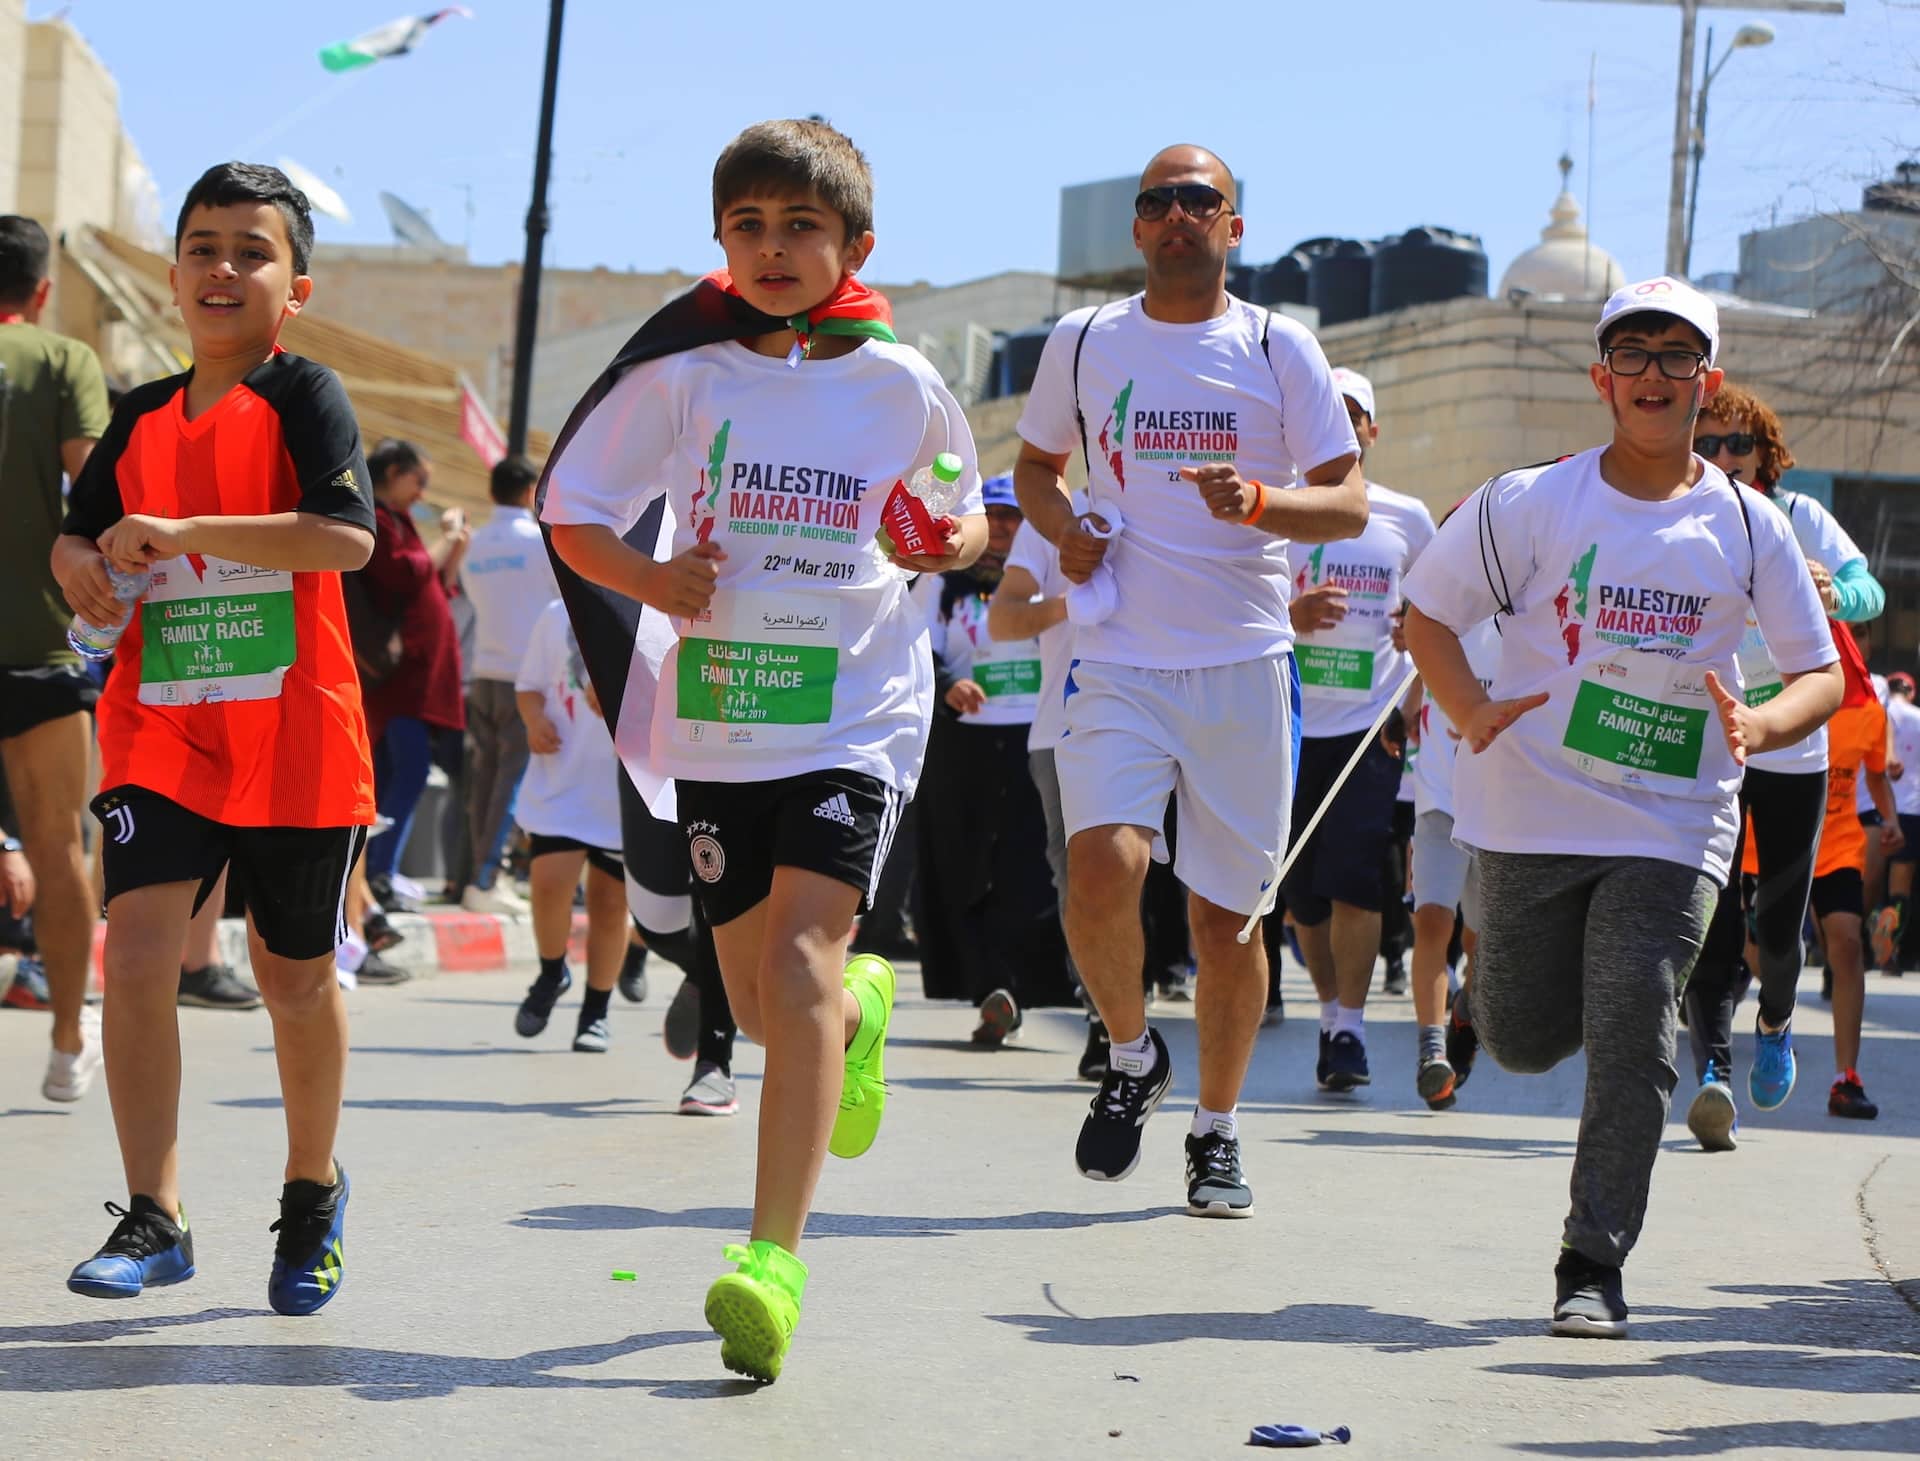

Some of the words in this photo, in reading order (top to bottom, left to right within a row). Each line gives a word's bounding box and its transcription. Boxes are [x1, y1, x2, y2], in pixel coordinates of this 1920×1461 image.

[1134, 411, 1237, 431] PALESTINE
[1134, 431, 1237, 451] MARATHON
[1135, 451, 1173, 460] FREEDOM
[1176, 452, 1187, 460] OF
[1189, 452, 1235, 461] MOVEMENT
[731, 462, 867, 501] PALESTINE
[1168, 471, 1181, 481] 22
[729, 492, 860, 530] MARATHON
[728, 520, 779, 537] FREEDOM
[782, 524, 797, 537] OF
[800, 526, 857, 545] MOVEMENT
[763, 555, 792, 571] 22nd
[793, 558, 821, 576] Mar
[823, 562, 855, 580] 2019
[1327, 563, 1392, 581] PALESTINE
[164, 602, 210, 620] العائلة
[215, 601, 256, 618] سباق
[762, 612, 794, 626] للحرية
[797, 615, 828, 628] اركضوا
[161, 623, 209, 645] FAMILY
[216, 619, 264, 640] RACE
[707, 643, 751, 662] العائلة
[755, 649, 798, 666] سباق
[214, 662, 234, 672] 2019
[700, 664, 749, 686] FAMILY
[754, 669, 804, 688] RACE
[167, 687, 173, 696] 5
[732, 709, 747, 719] Mar
[748, 709, 767, 719] 2019
[1612, 694, 1659, 718] العائلة
[1659, 709, 1687, 724] سباق
[694, 726, 700, 736] 5
[1597, 710, 1653, 739] FAMILY
[1654, 725, 1687, 745] RACE
[812, 805, 856, 827] adidas
